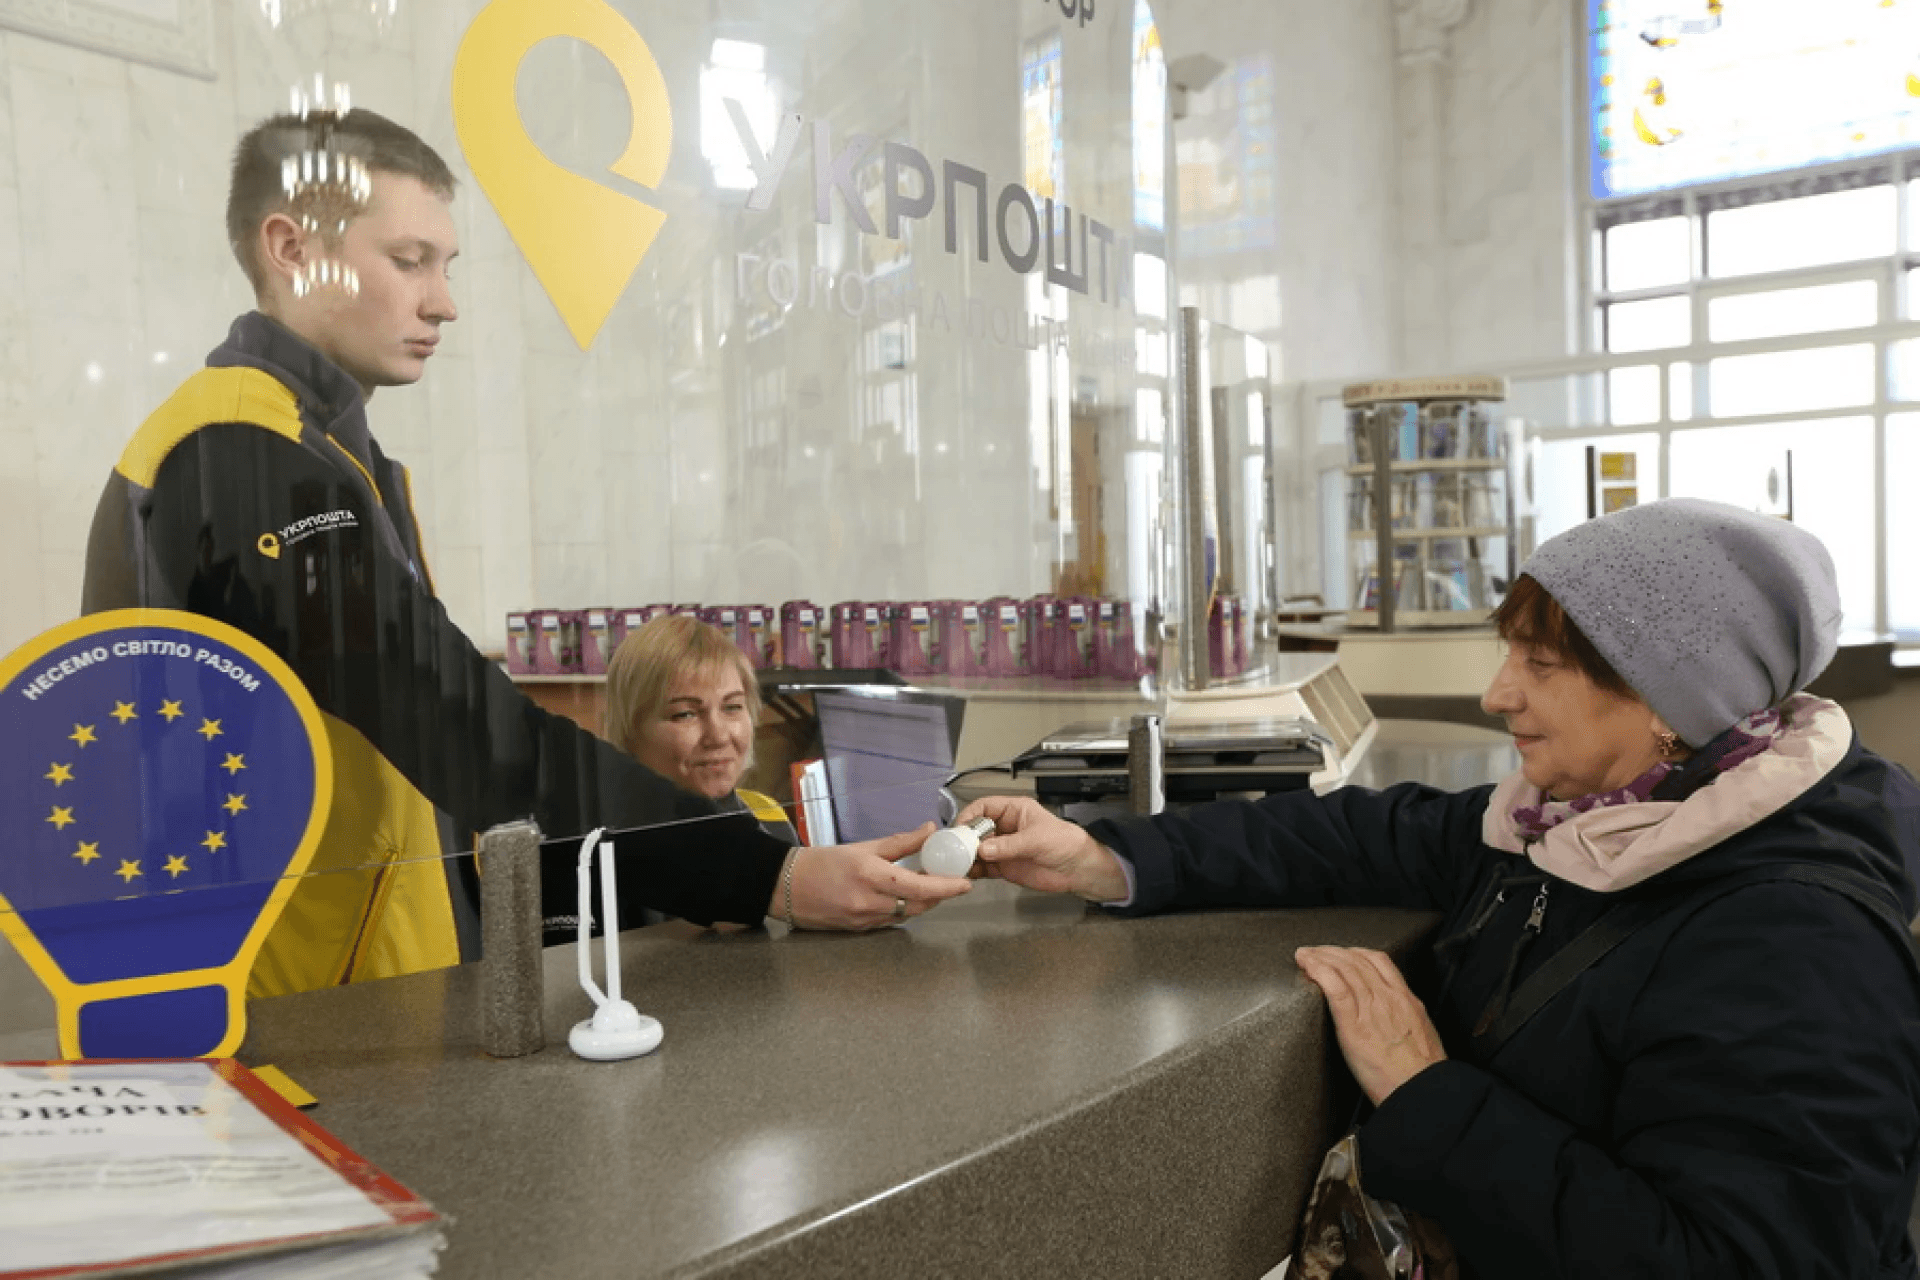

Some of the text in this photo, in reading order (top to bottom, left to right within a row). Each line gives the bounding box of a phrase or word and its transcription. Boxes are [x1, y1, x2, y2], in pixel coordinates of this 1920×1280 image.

[22, 640, 260, 700] НЕСЕМО СВІТЛО РАЗОМ
